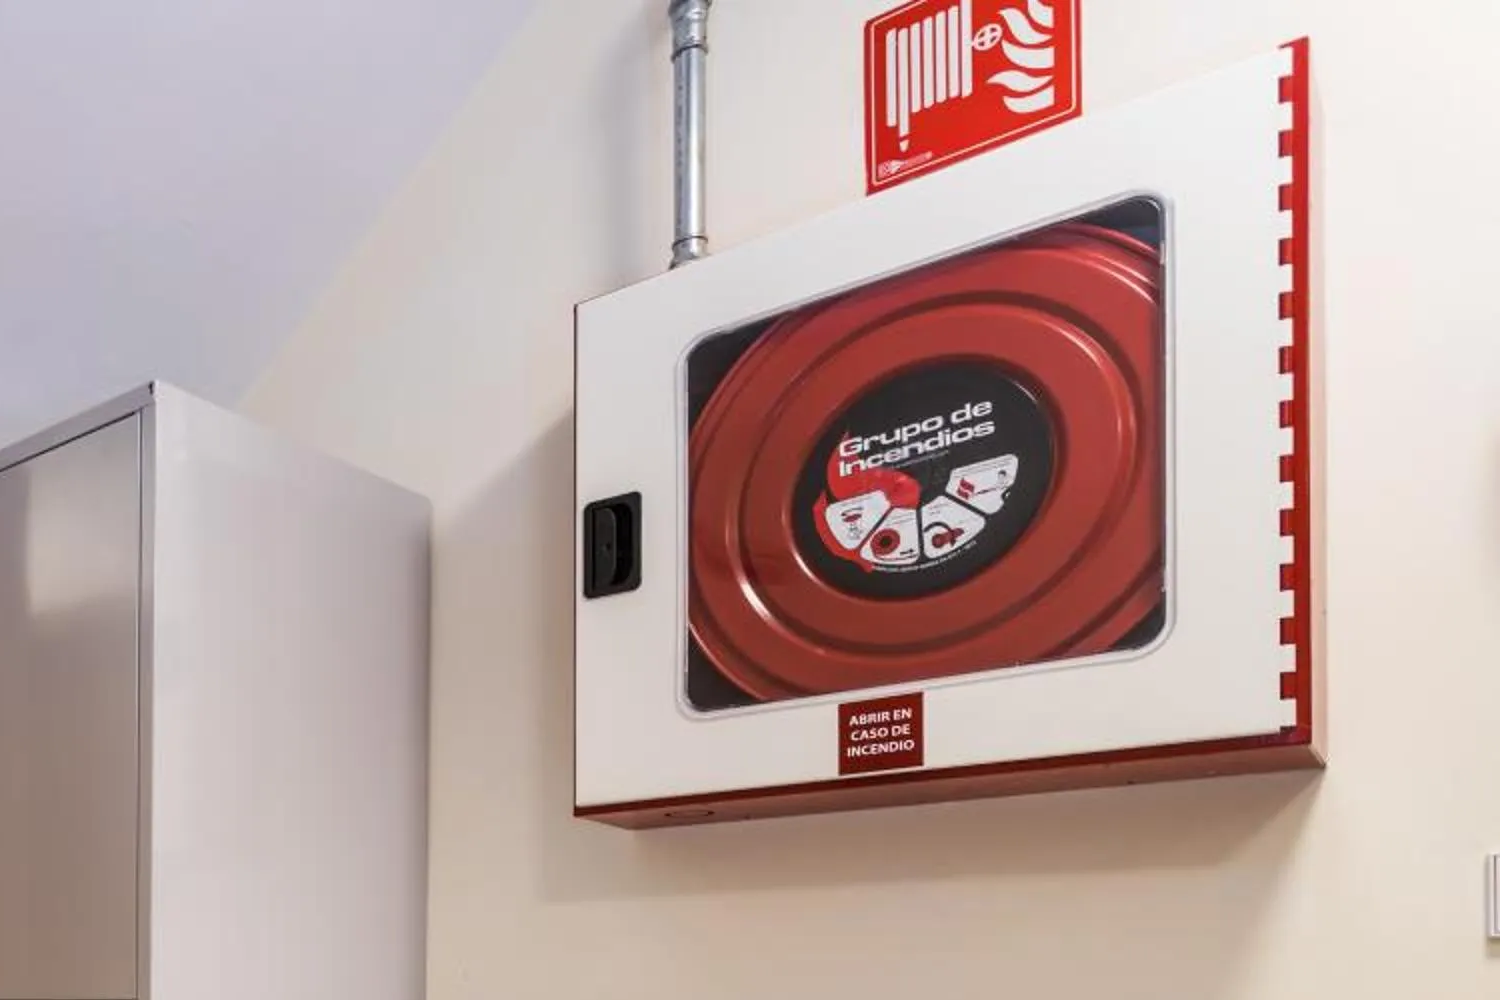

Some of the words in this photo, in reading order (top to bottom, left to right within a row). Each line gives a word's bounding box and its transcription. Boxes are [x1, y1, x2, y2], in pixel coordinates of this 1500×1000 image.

[839, 415, 944, 457] Grupo
[951, 401, 993, 424] de
[839, 421, 996, 477] Incendios
[849, 711, 891, 726] ABRIR
[893, 707, 913, 720] EN
[851, 727, 889, 741] CASO
[891, 724, 911, 737] DE
[847, 739, 915, 757] INCENDIO
